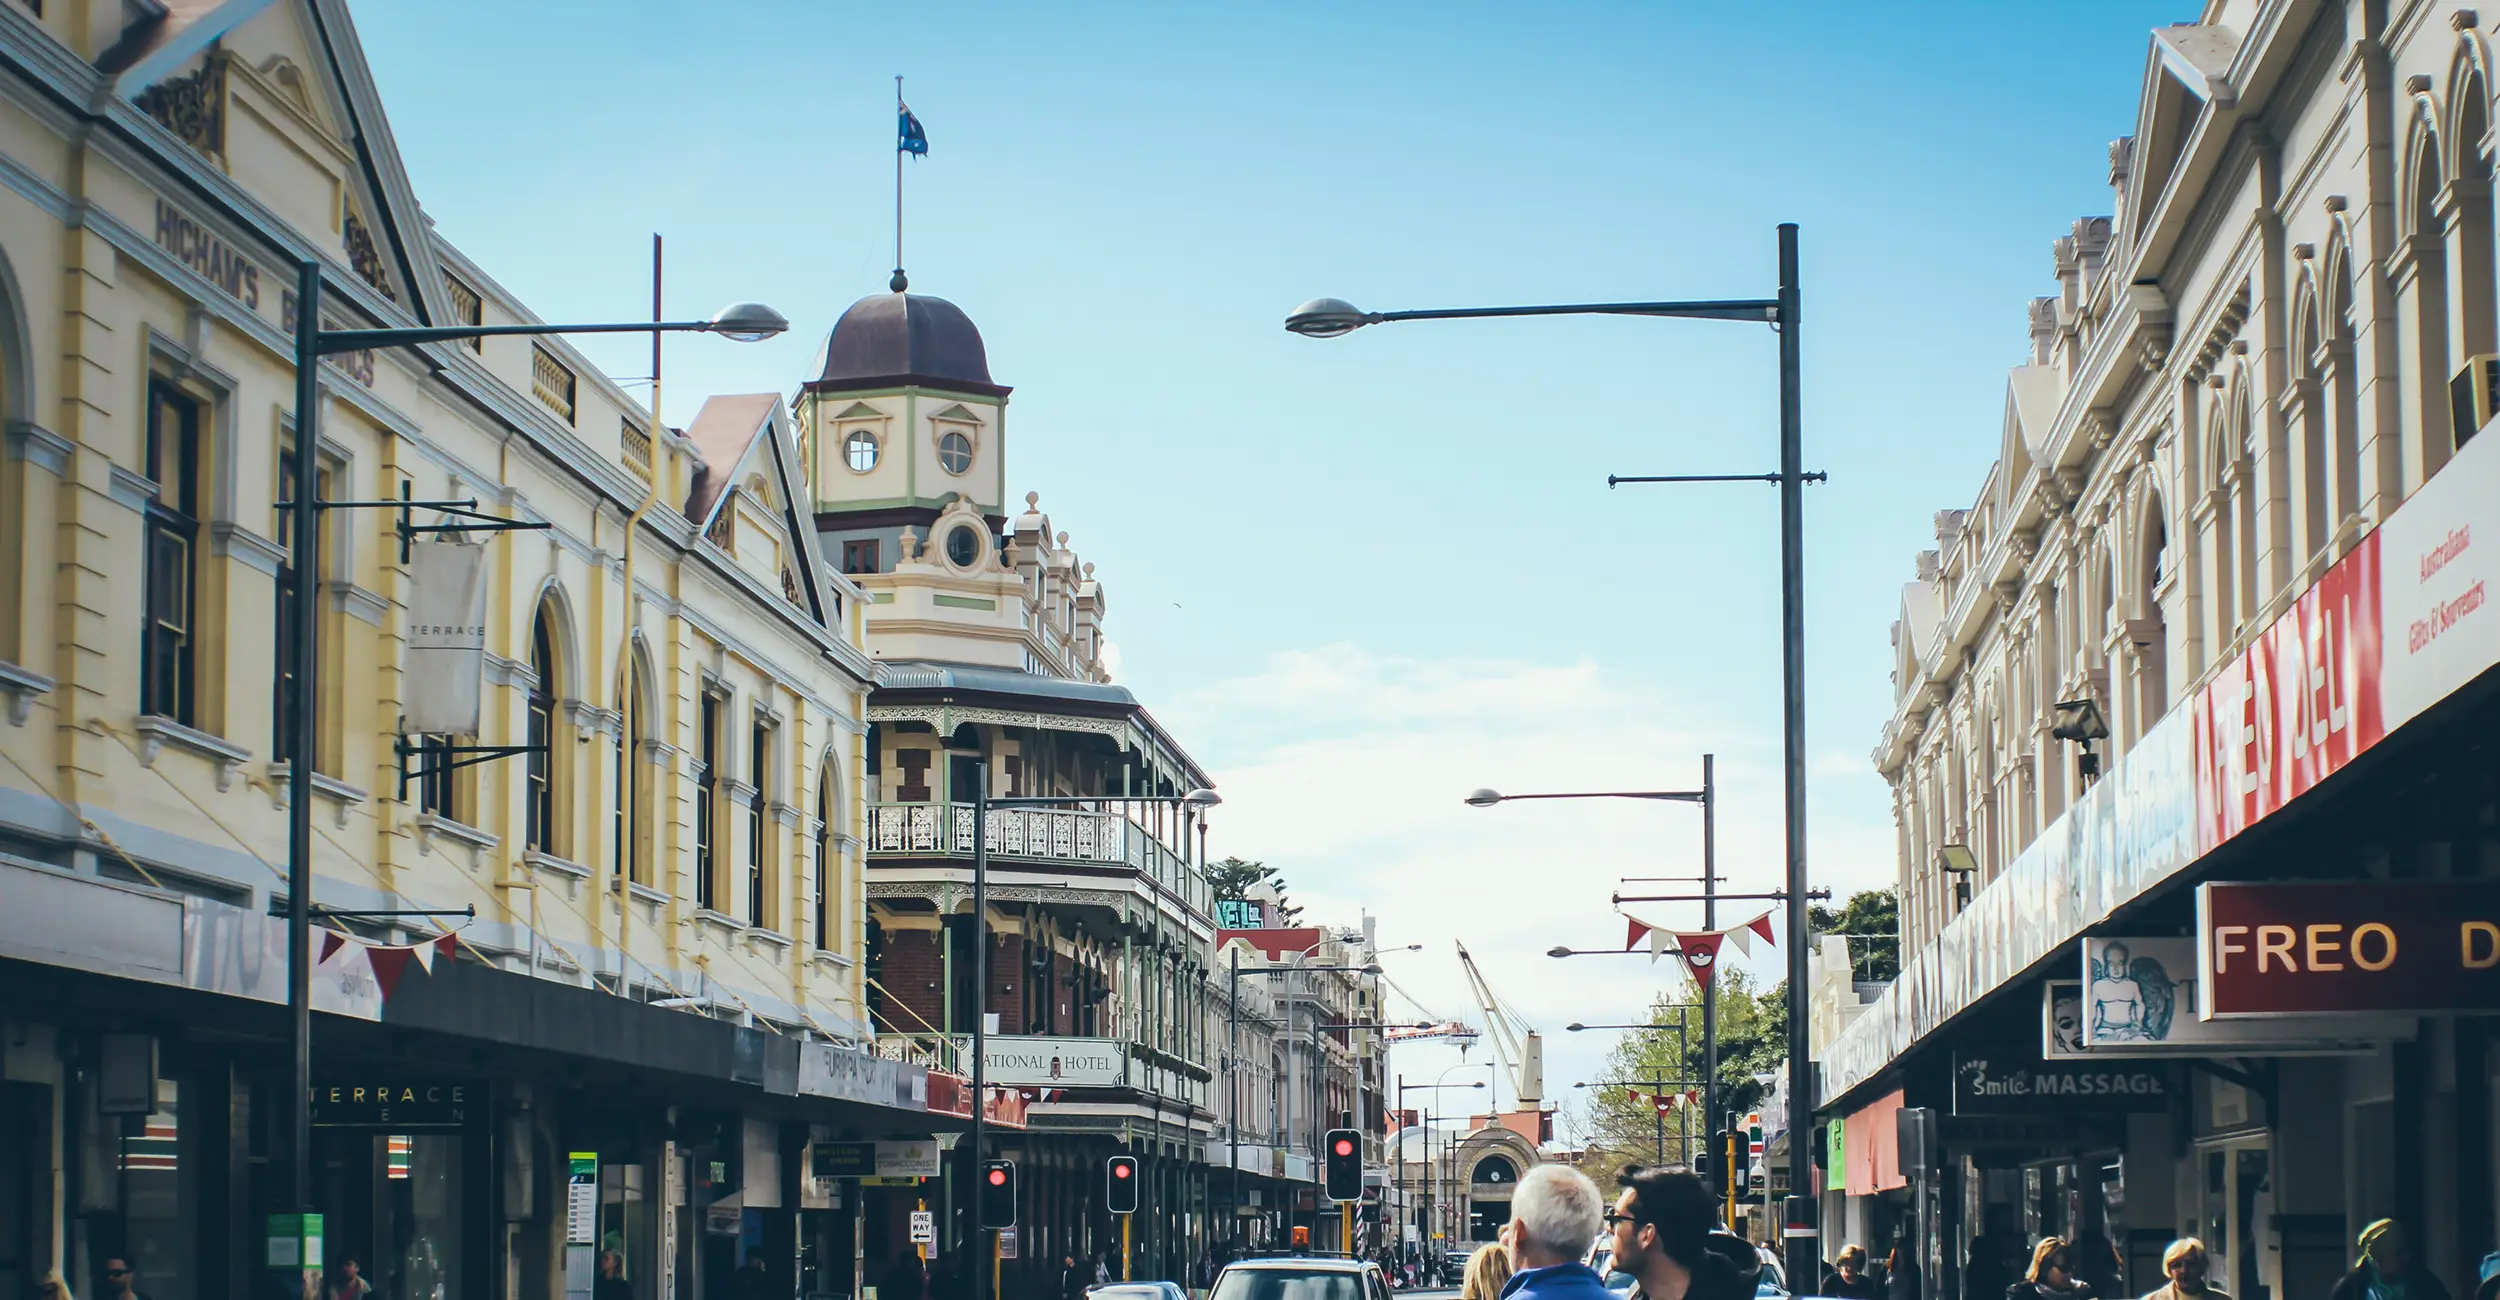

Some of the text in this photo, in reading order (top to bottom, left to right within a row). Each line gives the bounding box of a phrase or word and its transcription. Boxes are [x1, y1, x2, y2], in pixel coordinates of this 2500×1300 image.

[2420, 524, 2470, 585] Australiana
[2409, 619, 2430, 655] Gifts
[2440, 578, 2485, 633] Souvenirs
[410, 625, 485, 636] TERRACE
[2214, 667, 2273, 816] FREO
[2215, 922, 2398, 975] FREO
[971, 1054, 1112, 1071] ATIONAL HOTEL
[2035, 1074, 2164, 1095] MASSAGE
[307, 1087, 464, 1103] TERRACE
[913, 1214, 929, 1222] ONE
[912, 1224, 930, 1232] WAY
